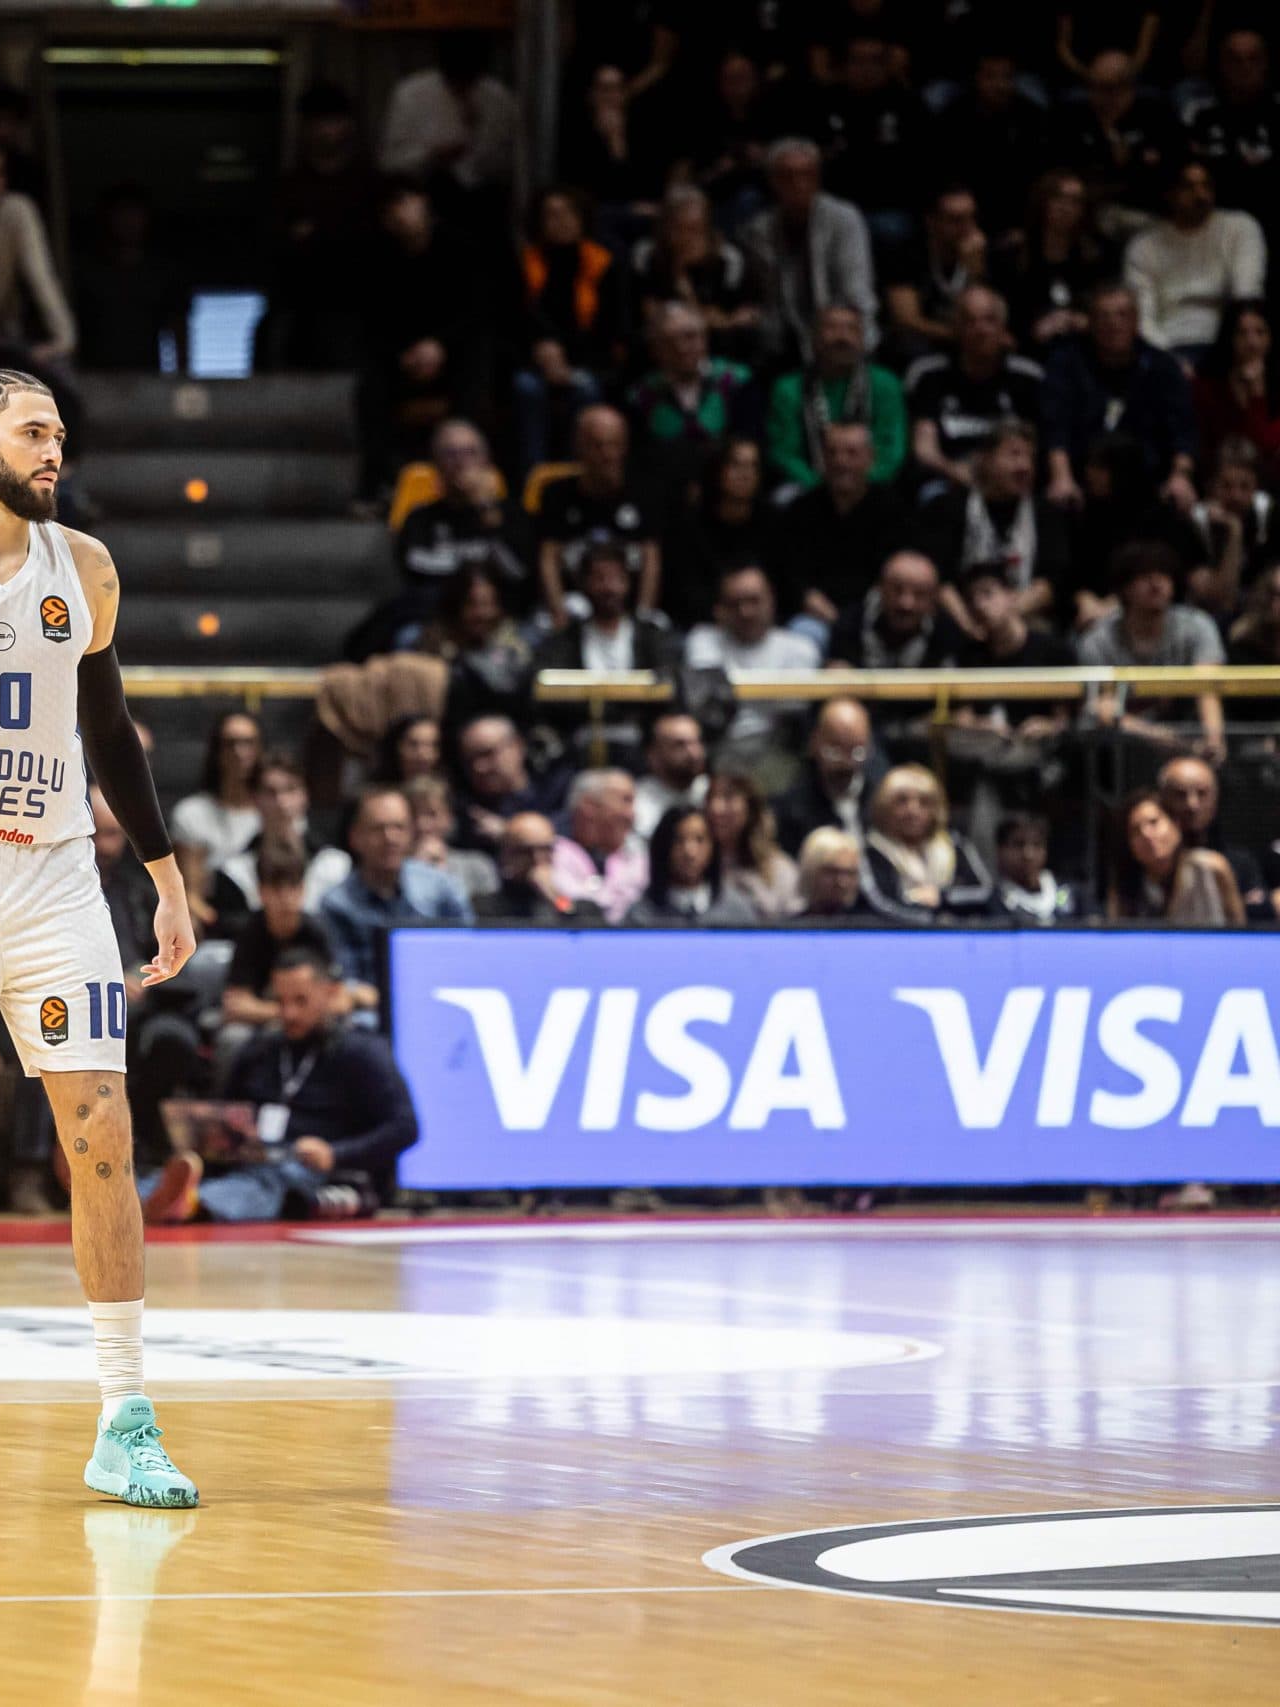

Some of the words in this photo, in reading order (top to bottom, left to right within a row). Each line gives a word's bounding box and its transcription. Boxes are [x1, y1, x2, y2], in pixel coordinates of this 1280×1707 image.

[85, 982, 126, 1039] 10
[433, 986, 847, 1131] VISA
[893, 986, 1280, 1129] VISA
